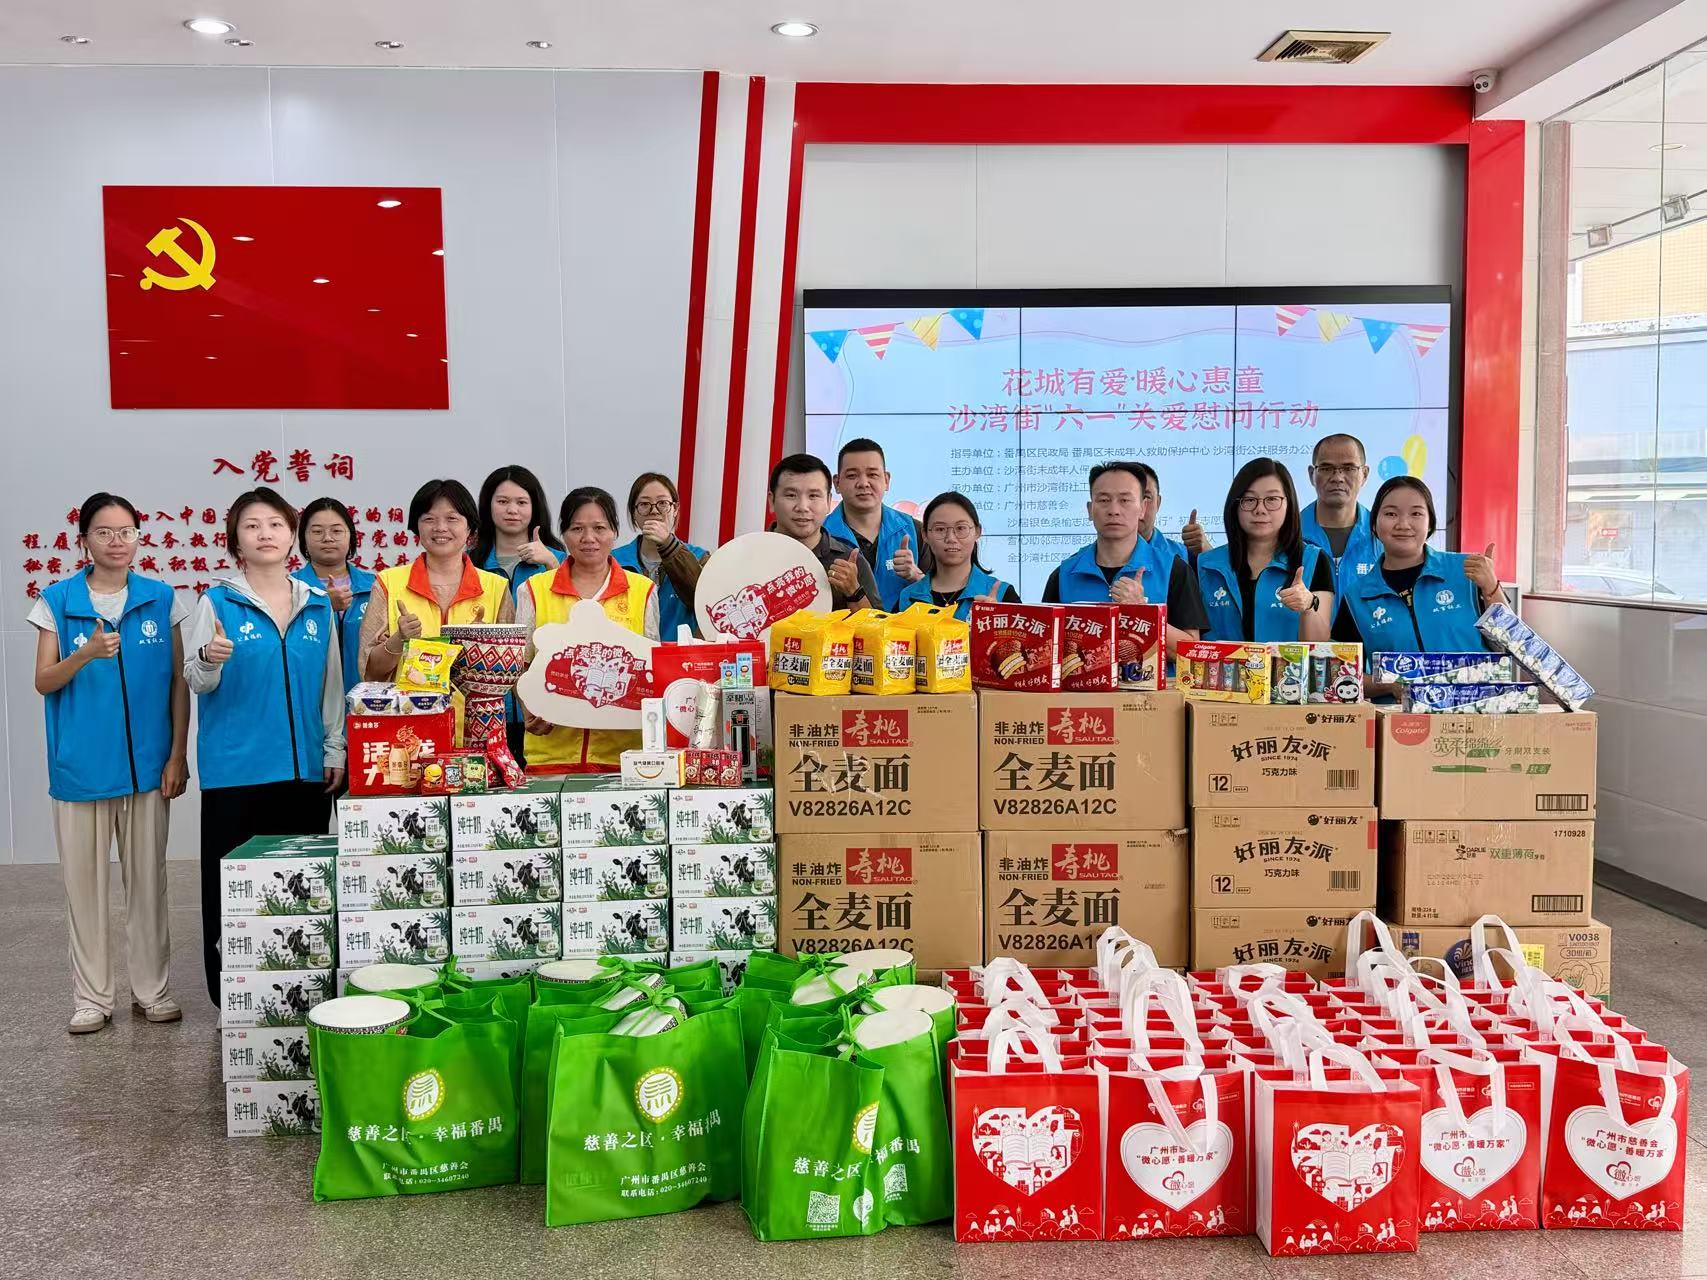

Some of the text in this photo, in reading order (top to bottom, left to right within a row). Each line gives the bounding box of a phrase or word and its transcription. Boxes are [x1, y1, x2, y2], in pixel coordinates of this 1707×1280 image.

[1002, 366, 1265, 397] 花城有爱·暖心惠童
[213, 449, 355, 484] 入党誓词
[766, 565, 806, 595] 点亮我的
[786, 574, 817, 598] 微心愿
[976, 613, 1047, 638] 好丽友·派
[828, 657, 851, 670] 全麦面
[890, 656, 914, 668] 全麦面
[1185, 649, 1222, 660] 高露洁
[779, 655, 812, 675] 全麦面
[789, 723, 840, 738] 非油炸
[845, 710, 902, 741] 寿桃
[994, 708, 1107, 739] 非油炸 寿桃
[1321, 714, 1357, 724] 好丽友
[994, 735, 1114, 746] NON-FRIED SAUTAO
[1395, 727, 1427, 735] Colgate
[788, 738, 908, 748] NON-FRIED SAUTAO
[1231, 735, 1333, 763] 好丽友·派
[1504, 747, 1551, 756] 牙刷双支装
[788, 751, 912, 795] 全麦面
[993, 750, 1118, 793] 全麦面
[1262, 767, 1298, 777] 巧克力味
[1212, 775, 1229, 791] 12
[788, 799, 912, 817] V82826A12C
[993, 798, 1118, 815] V82826A12C
[457, 815, 482, 835] 纯牛奶
[568, 811, 592, 831] 纯牛奶
[676, 809, 700, 828] 纯牛奶
[1323, 815, 1359, 825] 好丽友
[345, 819, 369, 838] 纯牛奶
[1553, 830, 1586, 838] 1710928
[999, 844, 1111, 875] 非油炸 寿桃
[1233, 836, 1334, 864] 好丽友·派
[678, 863, 702, 881] 纯牛奶
[792, 848, 905, 880] 非油炸 寿桃
[1264, 868, 1300, 878] 巧克力味
[343, 875, 367, 894] 纯牛奶
[459, 871, 483, 889] 纯牛奶
[569, 866, 593, 885] 纯牛奶
[792, 875, 913, 887] NON-FRIED SAUTAO
[998, 872, 1119, 881] NON-FRIED SAUTAO
[1214, 876, 1231, 893] 12
[228, 879, 253, 898] 纯牛奶
[792, 890, 914, 932] 全麦面
[998, 887, 1121, 927] 全麦面
[569, 921, 593, 940] 纯牛奶
[679, 916, 703, 935] 纯牛奶
[346, 931, 371, 950] 纯牛奶
[459, 926, 484, 945] 纯牛奶
[1569, 933, 1600, 942] V0038
[227, 936, 253, 955] 纯牛奶
[1232, 937, 1333, 964] 好丽友·派
[228, 992, 253, 1011] 纯牛奶
[229, 1047, 254, 1066] 纯牛奶
[233, 1102, 259, 1121] 纯牛奶
[1595, 1129, 1660, 1148] 广州市慈善会
[620, 1162, 707, 1186] 广州市番禺区慈善会
